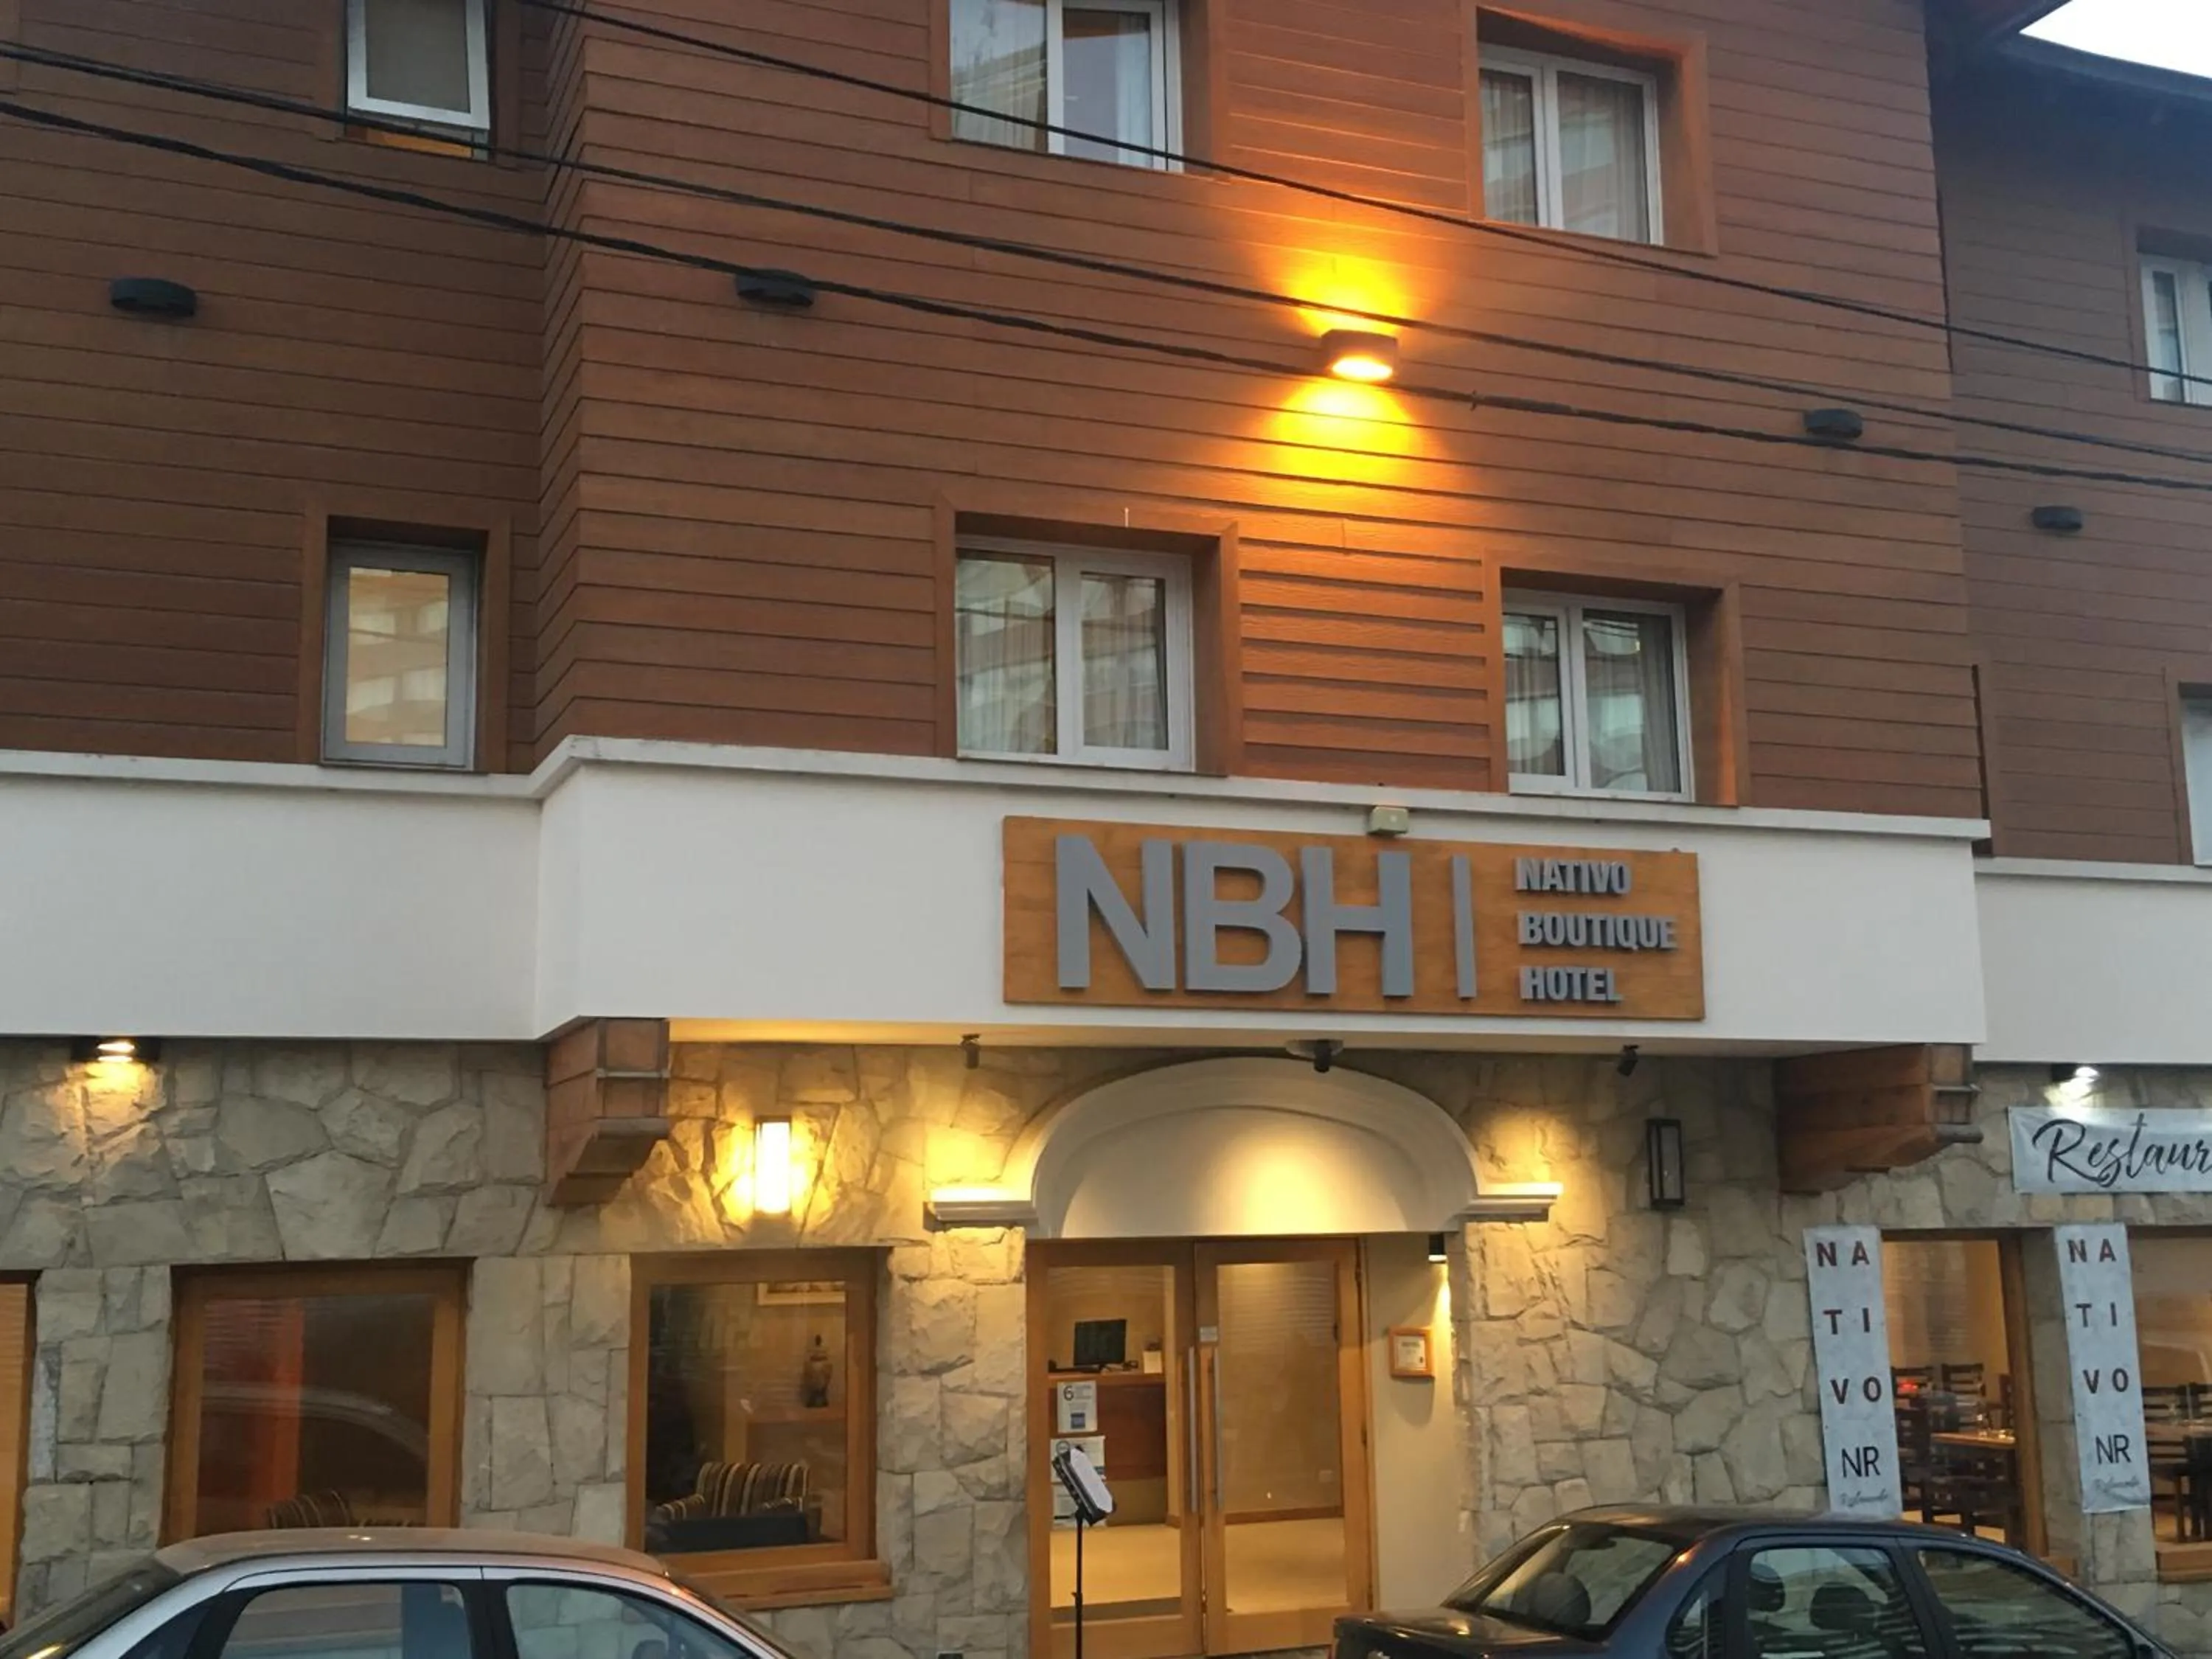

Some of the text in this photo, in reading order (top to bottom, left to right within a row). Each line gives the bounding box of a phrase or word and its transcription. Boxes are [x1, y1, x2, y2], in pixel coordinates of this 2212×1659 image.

[1515, 857, 1632, 894] NATIVO
[1054, 833, 1415, 998] NBH
[1517, 910, 1679, 951] BOUTIQUE
[1519, 965, 1624, 1002] HOTEL
[2031, 1112, 2212, 1188] Restaur
[1840, 1446, 1881, 1478] NR
[2095, 1433, 2132, 1465] NR
